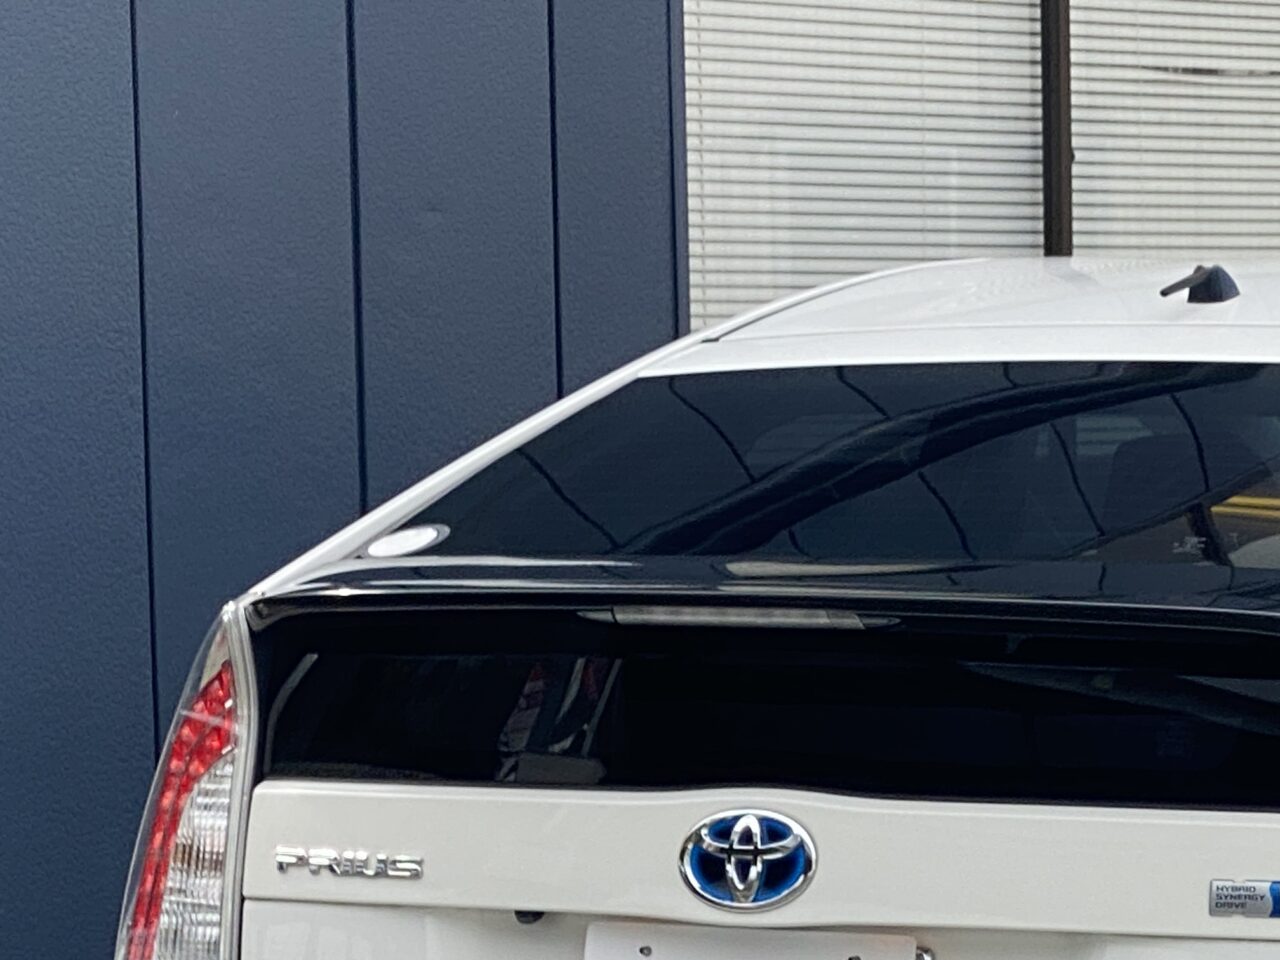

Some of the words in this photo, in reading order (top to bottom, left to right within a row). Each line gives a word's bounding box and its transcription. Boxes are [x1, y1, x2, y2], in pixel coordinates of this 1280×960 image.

[275, 846, 425, 879] PRIUS
[1216, 885, 1257, 893] HYBRID
[1215, 893, 1266, 902] SYNERGY
[1215, 901, 1248, 909] DRIVE
